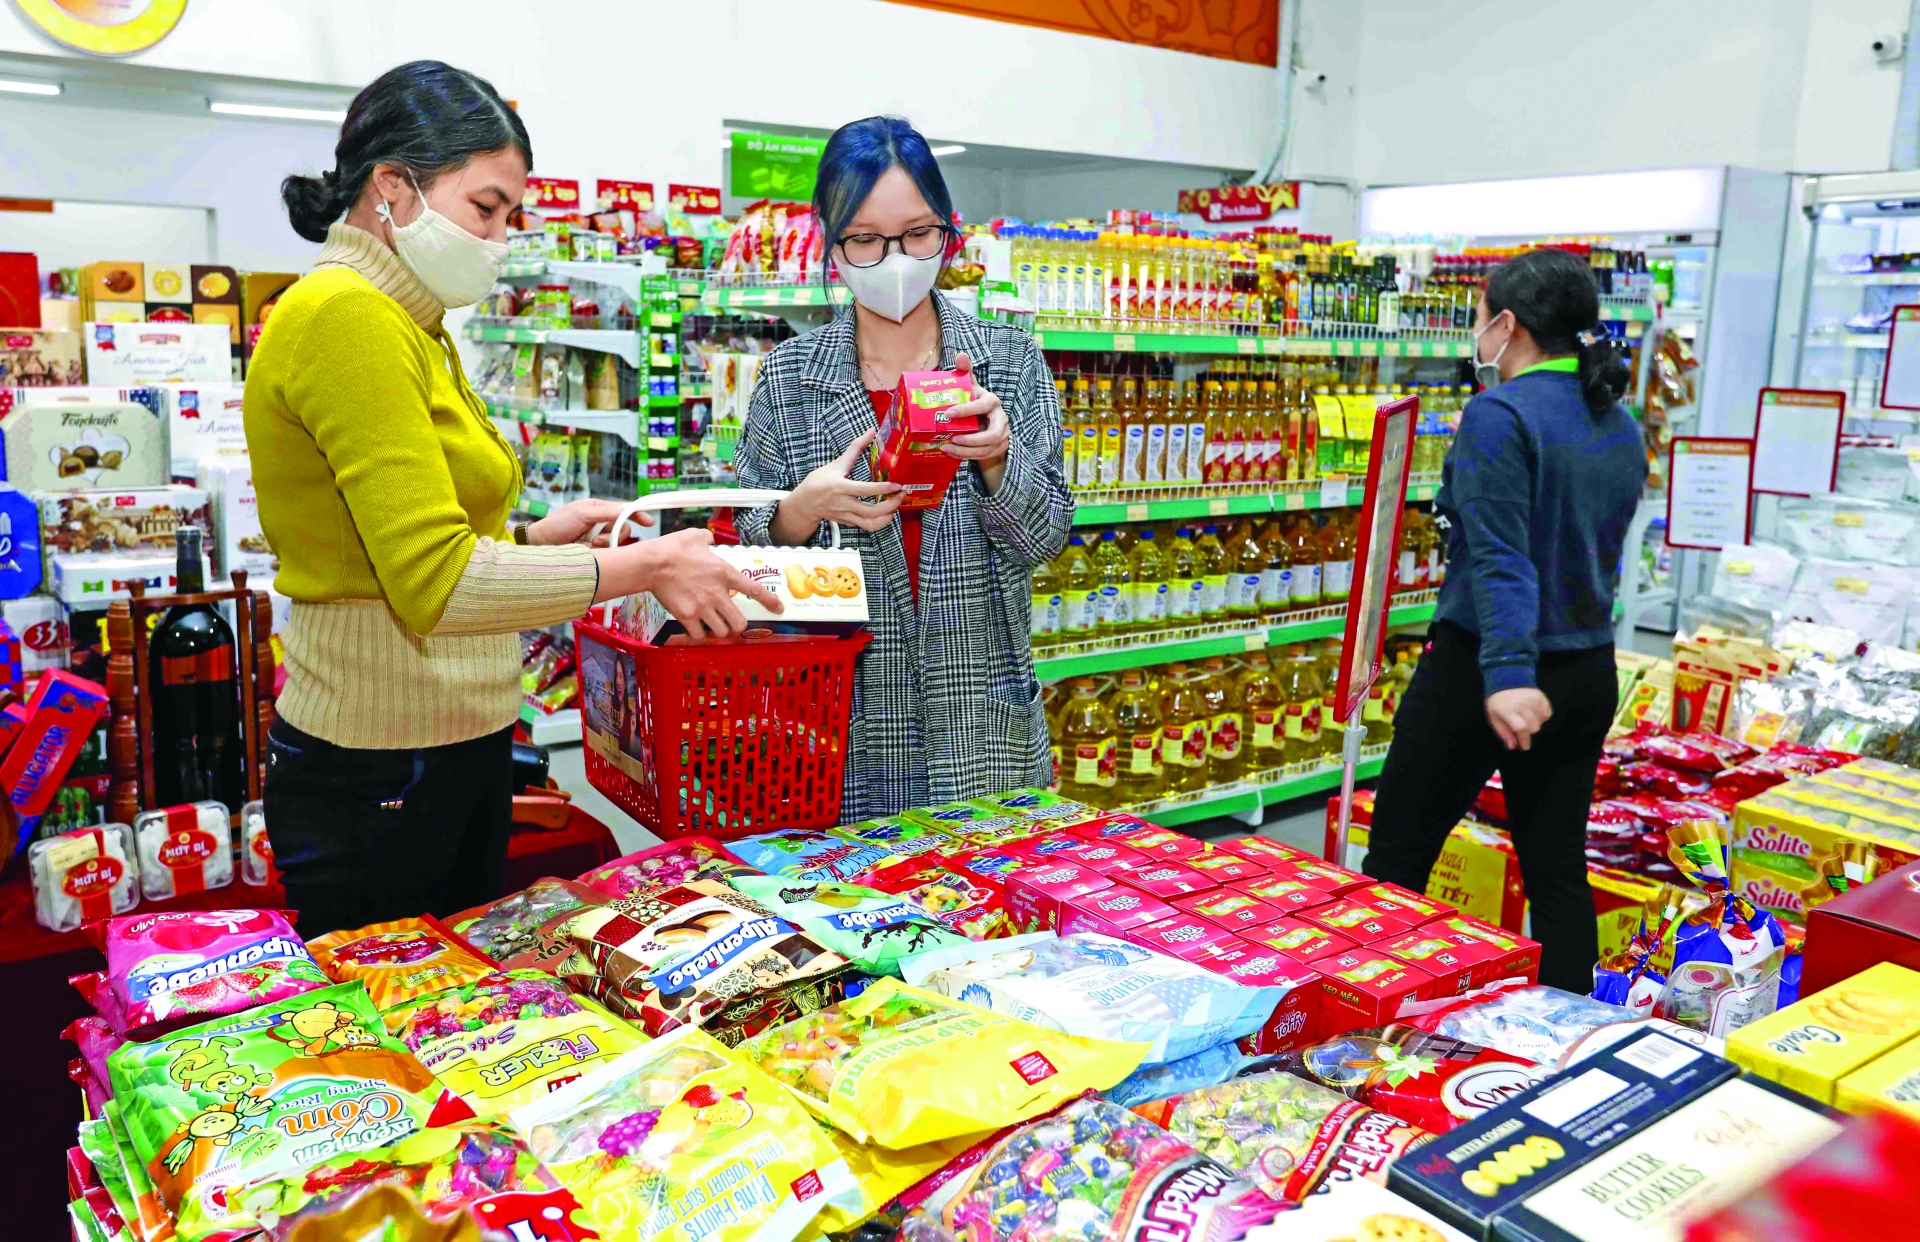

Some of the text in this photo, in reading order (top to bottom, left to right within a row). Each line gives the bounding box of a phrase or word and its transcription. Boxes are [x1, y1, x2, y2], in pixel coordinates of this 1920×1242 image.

[919, 378, 939, 388] Candy
[1747, 827, 1810, 855] Solite
[1440, 883, 1474, 906] TẾT
[1741, 881, 1802, 910] Solite
[148, 936, 312, 996] Alpenliebe
[354, 944, 401, 960] Candy
[669, 917, 778, 987] Alpenliebe
[469, 1024, 517, 1051] Soft
[1274, 1011, 1308, 1040] Toffy
[1278, 1040, 1295, 1053] Candy
[838, 1033, 935, 1097] Thailand
[280, 1078, 387, 1111] Spring Rice
[276, 1091, 405, 1139] Cốm
[1318, 1114, 1345, 1140] Chewy
[755, 1141, 785, 1165] FRUIT
[1300, 1141, 1328, 1176] Candy
[710, 1162, 752, 1197] YOGURT
[1155, 1162, 1236, 1223] Mixed
[1580, 1151, 1667, 1204] BUTTER
[1613, 1163, 1707, 1222] COOKIES
[675, 1184, 707, 1212] SOFT
[683, 1195, 739, 1242] FRUITS
